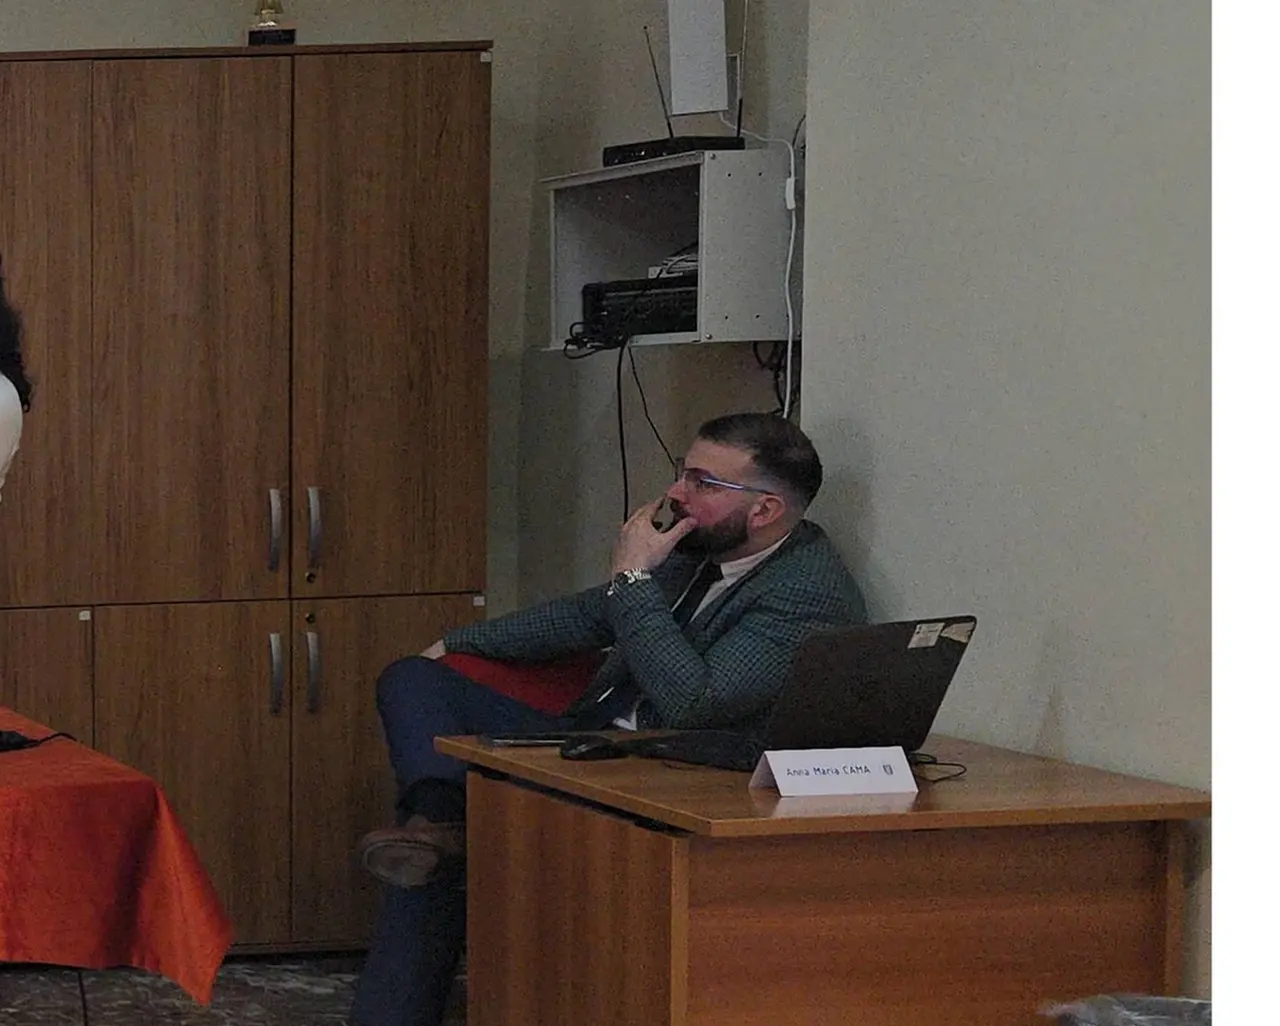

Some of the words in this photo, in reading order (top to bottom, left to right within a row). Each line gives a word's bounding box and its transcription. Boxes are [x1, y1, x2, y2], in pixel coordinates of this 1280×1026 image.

[786, 768, 810, 777] Anna
[812, 765, 840, 776] Maria
[841, 765, 872, 775] CAMA
